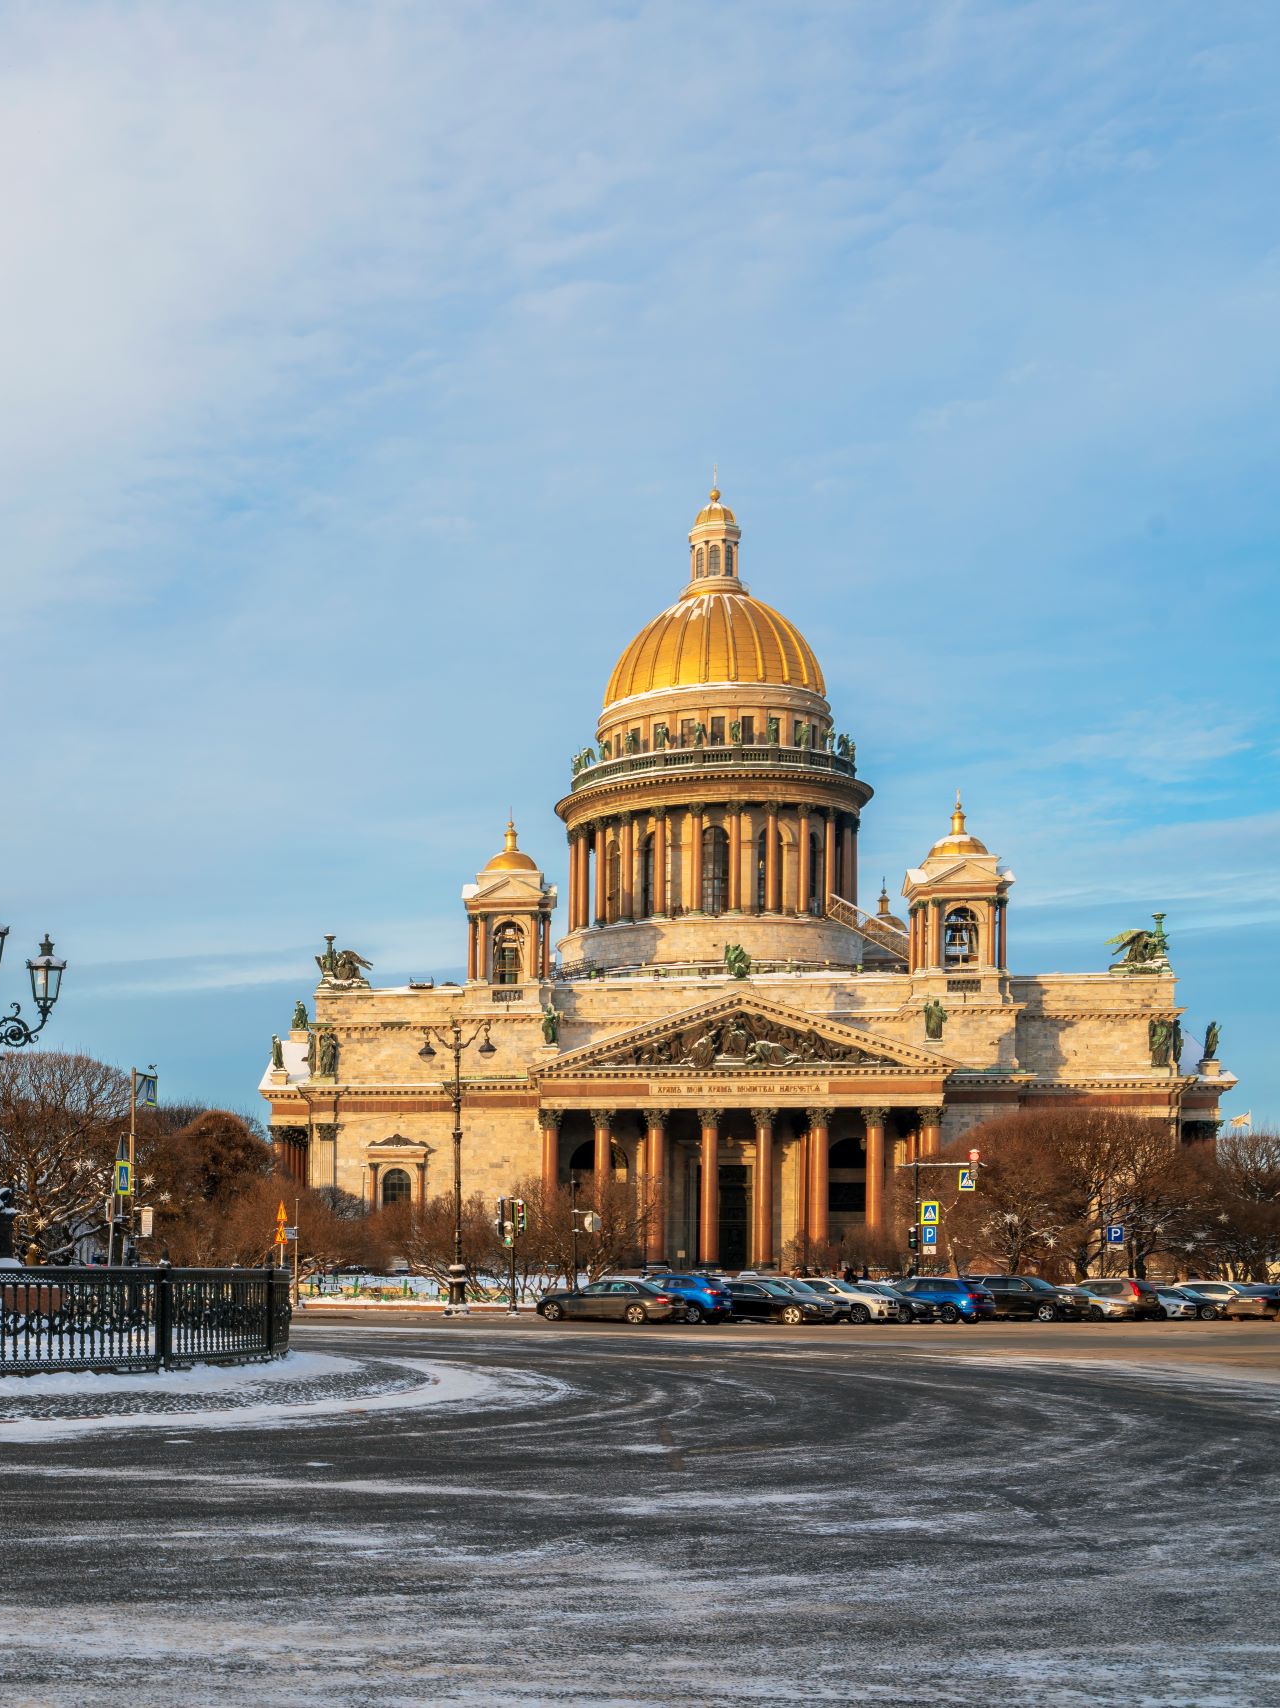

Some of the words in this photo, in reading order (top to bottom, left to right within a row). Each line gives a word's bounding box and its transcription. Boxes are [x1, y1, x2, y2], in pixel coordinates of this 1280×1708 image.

[657, 1086, 682, 1094] ХРАМЪ
[707, 1085, 733, 1093] ХРАМЪ
[926, 1228, 934, 1242] P
[1111, 1228, 1121, 1241] P
